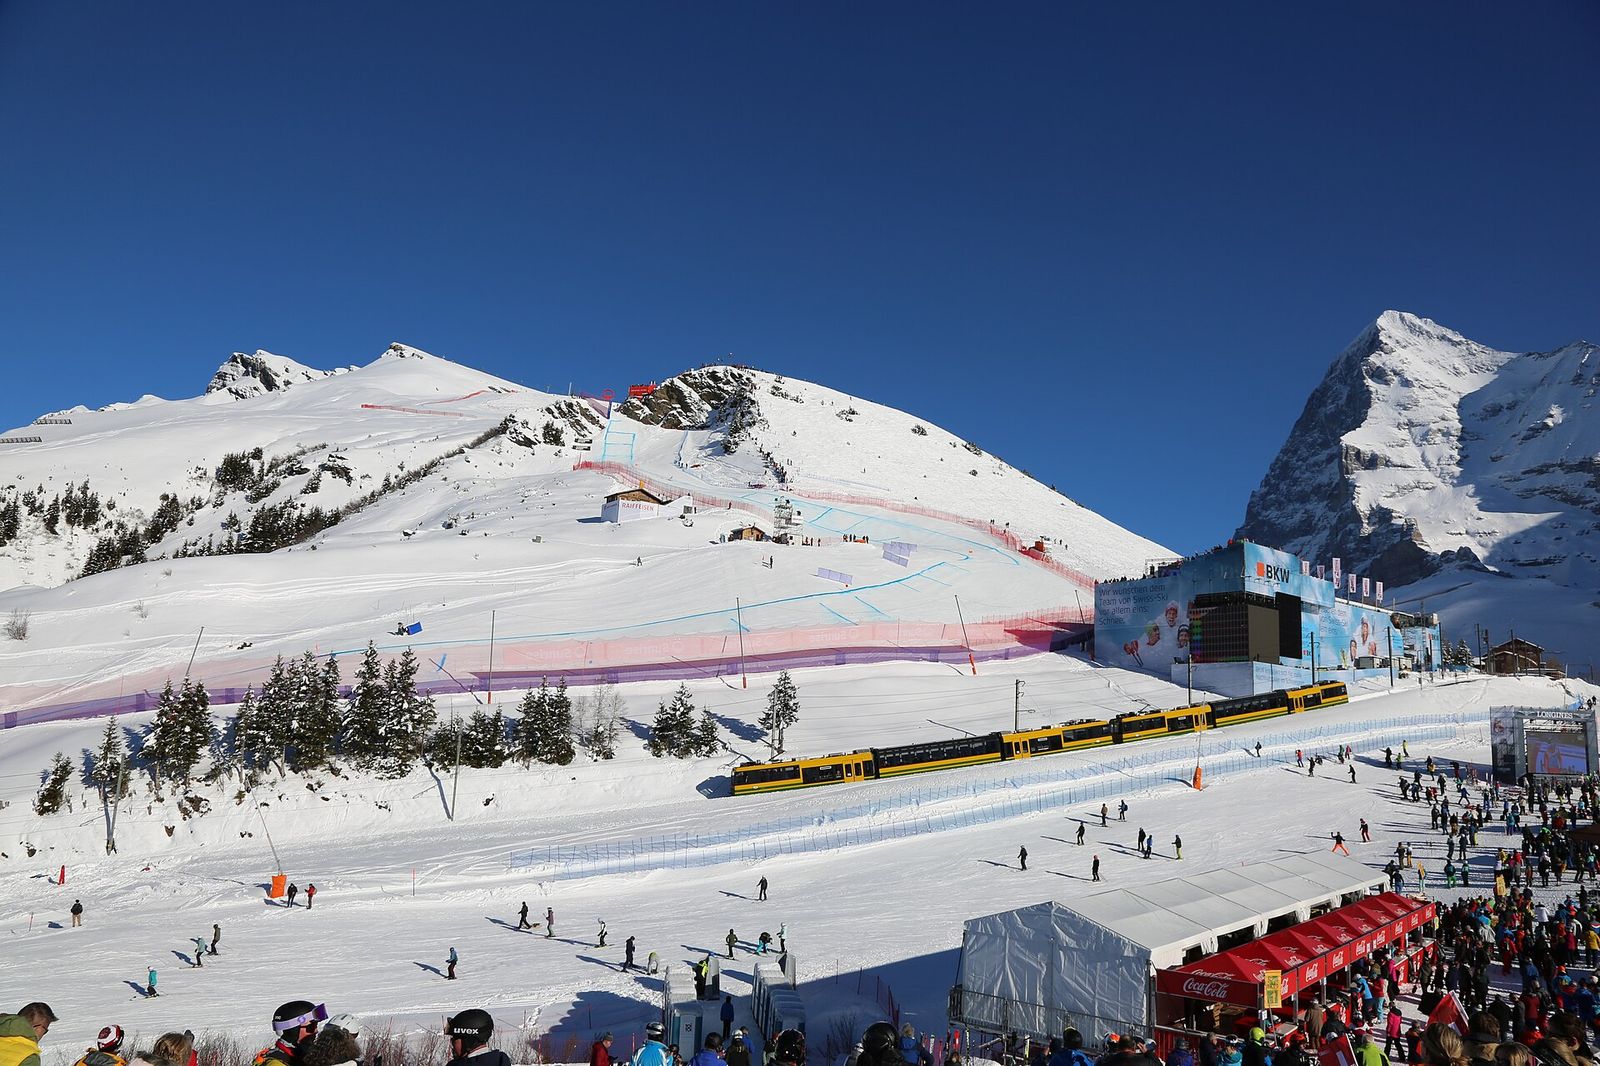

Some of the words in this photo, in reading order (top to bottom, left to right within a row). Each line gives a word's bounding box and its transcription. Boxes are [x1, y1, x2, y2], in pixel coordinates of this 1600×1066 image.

[622, 502, 654, 511] RAIFFEISEN
[1266, 564, 1290, 584] BKW
[1537, 710, 1574, 719] LONGINES
[1183, 978, 1231, 999] Coca-Cola
